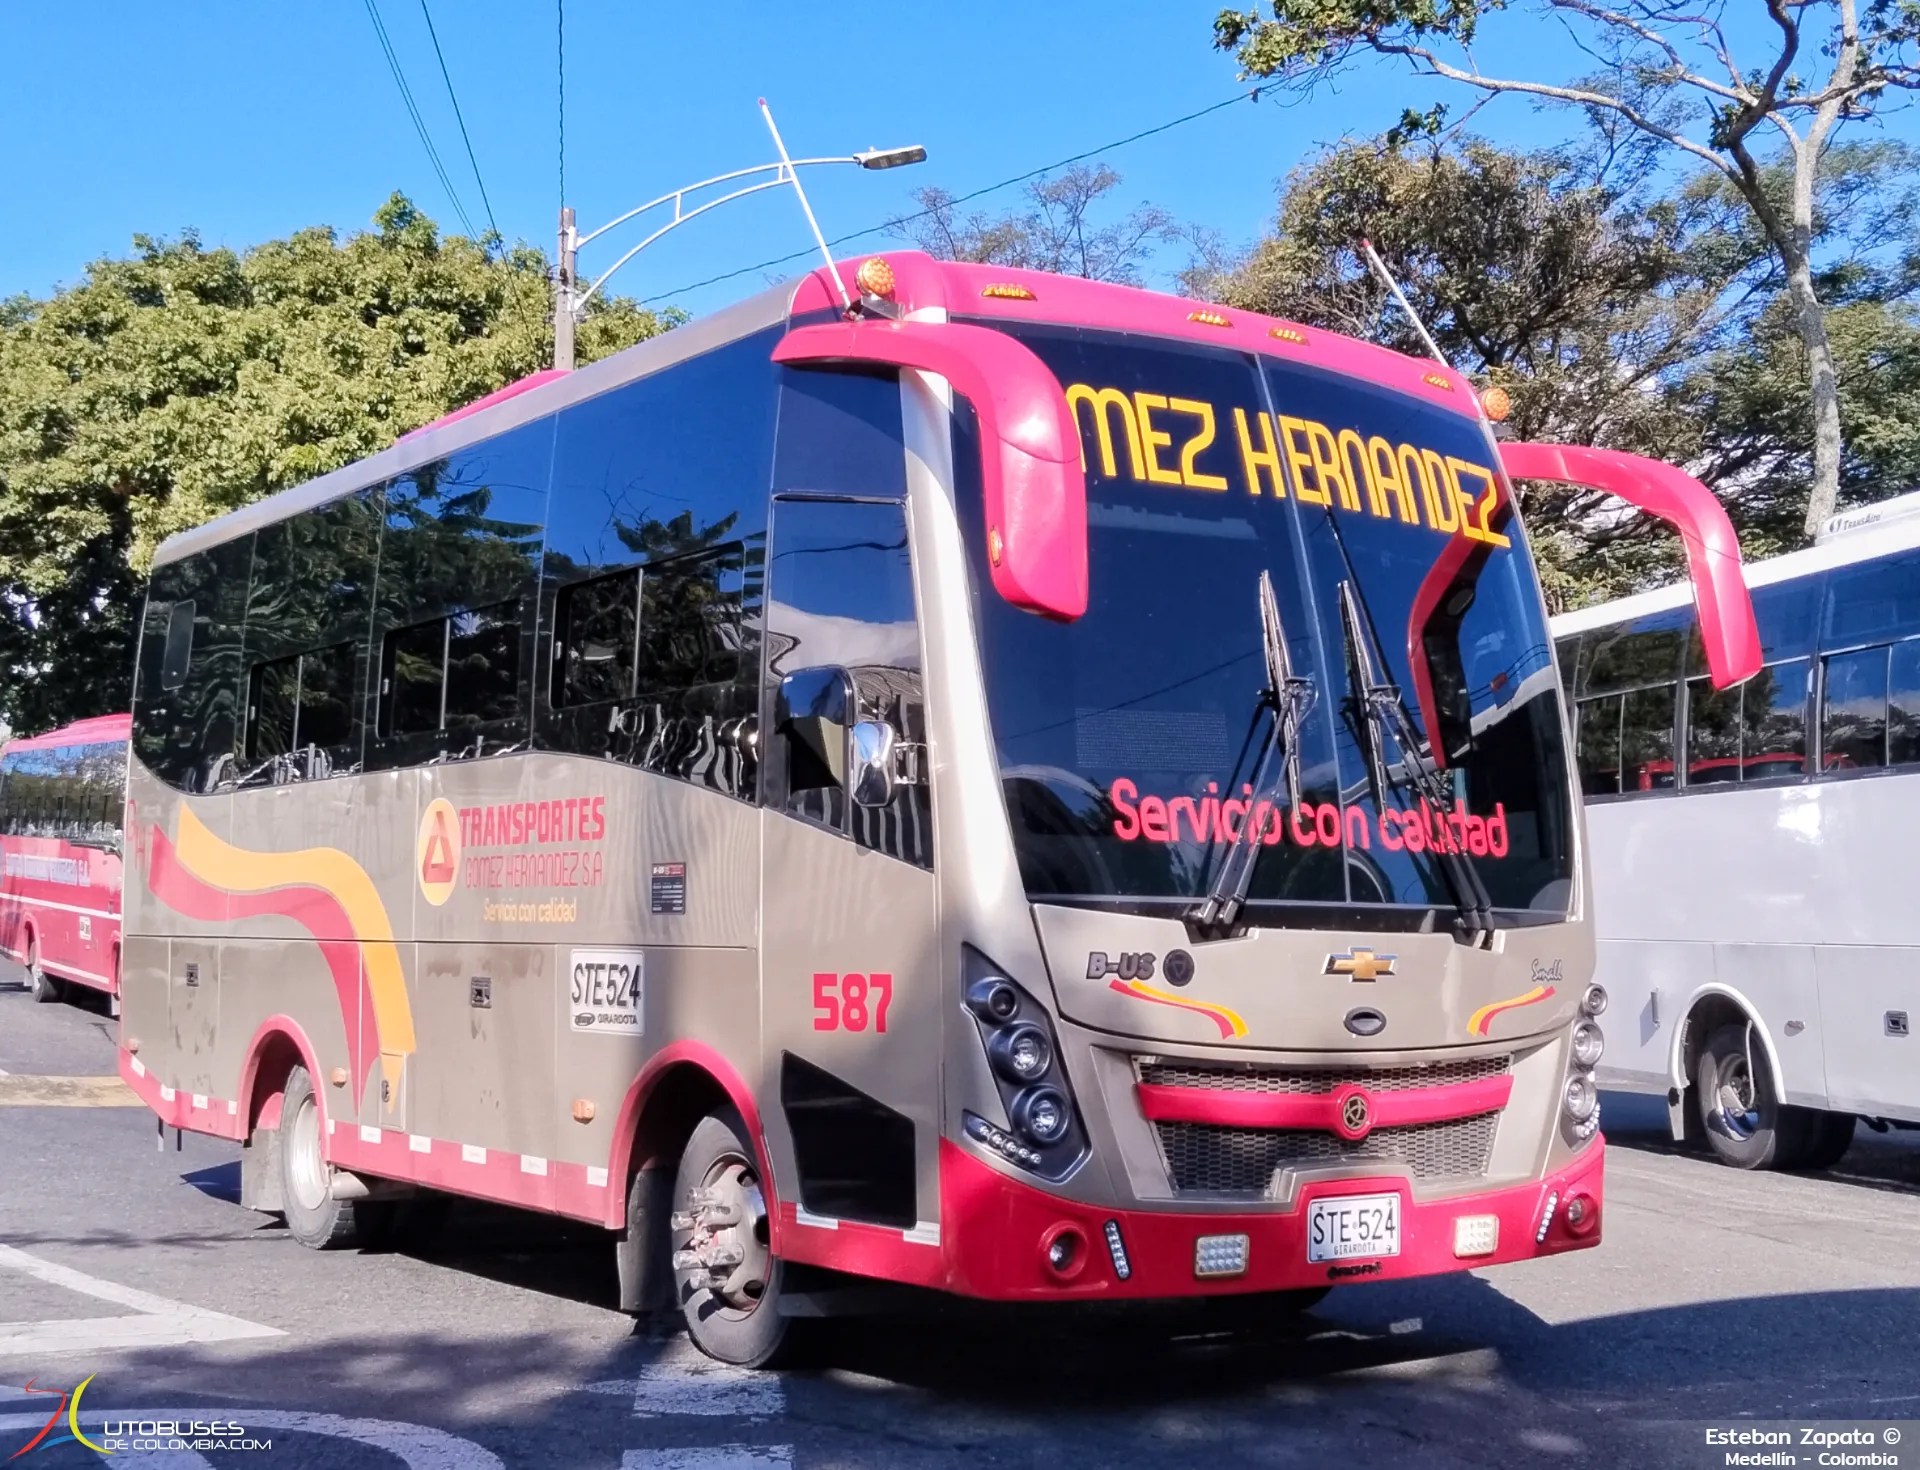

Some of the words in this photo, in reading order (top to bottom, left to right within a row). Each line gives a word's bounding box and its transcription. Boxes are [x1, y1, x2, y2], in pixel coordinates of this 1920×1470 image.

[1233, 407, 1511, 548] HERNANDEZ
[459, 796, 605, 847] TRANSPORTES
[1111, 777, 1282, 846] Servicio
[1291, 801, 1371, 850] con
[1379, 796, 1509, 857] calidad
[465, 855, 504, 888] GOMEZ
[506, 852, 579, 887] HERNANDEZ
[482, 896, 518, 922] Servicio
[518, 901, 537, 923] con
[537, 897, 577, 923] calidad
[1086, 951, 1157, 981] B-US
[1531, 957, 1563, 982] Small
[597, 1013, 639, 1025] GIRARDOTA
[813, 973, 893, 1033] 587
[1333, 1242, 1377, 1256] GIRARDOTA
